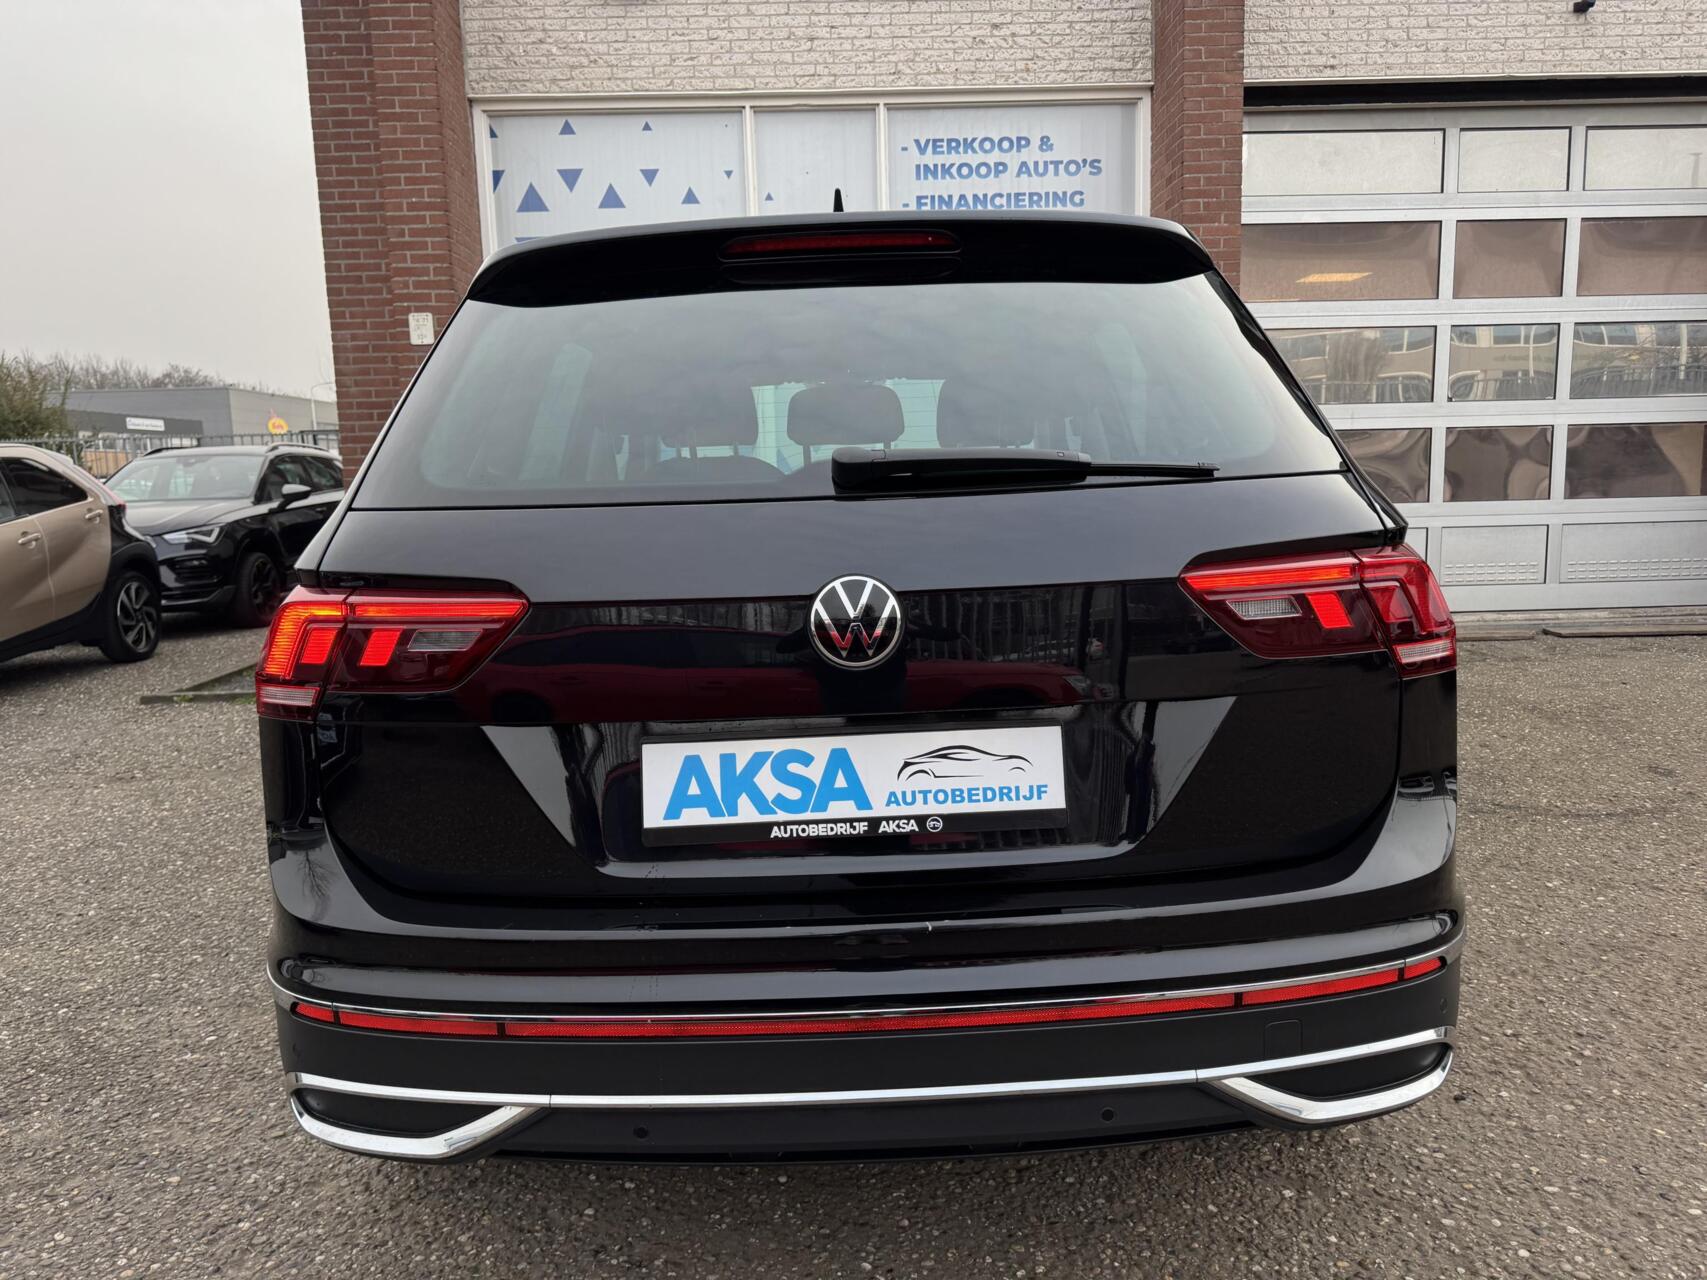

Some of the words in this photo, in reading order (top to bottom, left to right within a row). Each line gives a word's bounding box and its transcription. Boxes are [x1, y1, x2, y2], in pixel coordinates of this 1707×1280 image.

[913, 136, 1031, 155] VERKOOP
[1038, 135, 1054, 152] &
[914, 161, 1008, 181] INKOOP
[1015, 158, 1103, 178] AUTO'S
[915, 190, 1085, 210] FINANCIERING
[662, 747, 873, 821] AKSA
[885, 784, 1049, 807] AUTOBEDRIJF
[770, 822, 868, 838] AUTOBEDRIJF
[878, 819, 919, 833] AKSA
